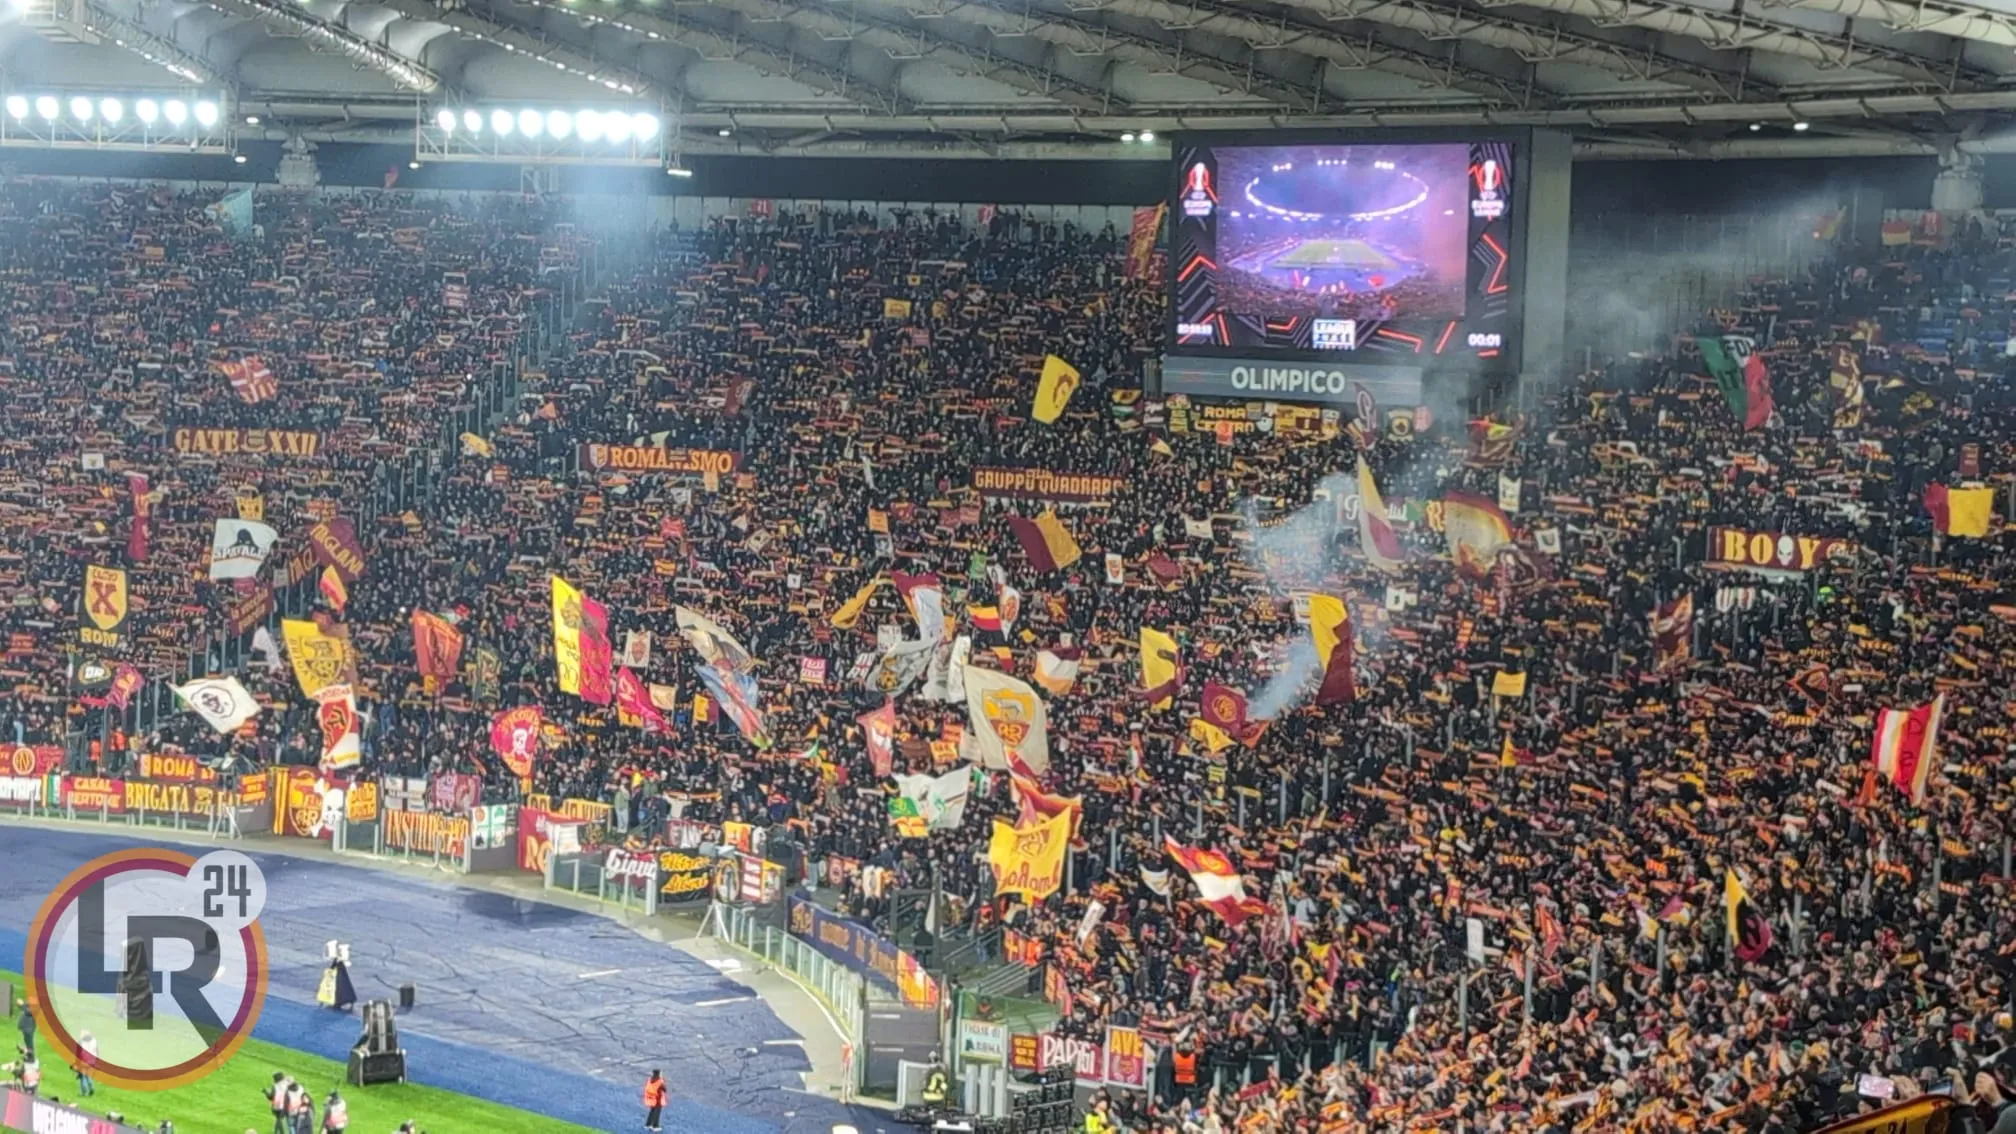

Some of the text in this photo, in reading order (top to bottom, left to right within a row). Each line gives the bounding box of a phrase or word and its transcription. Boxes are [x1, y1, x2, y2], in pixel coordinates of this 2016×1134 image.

[1231, 366, 1345, 394] OLIMPICO
[175, 429, 240, 453] GATE
[611, 446, 733, 472] ROMASMO
[80, 627, 120, 648] ROM
[125, 782, 190, 812] BRIGATA
